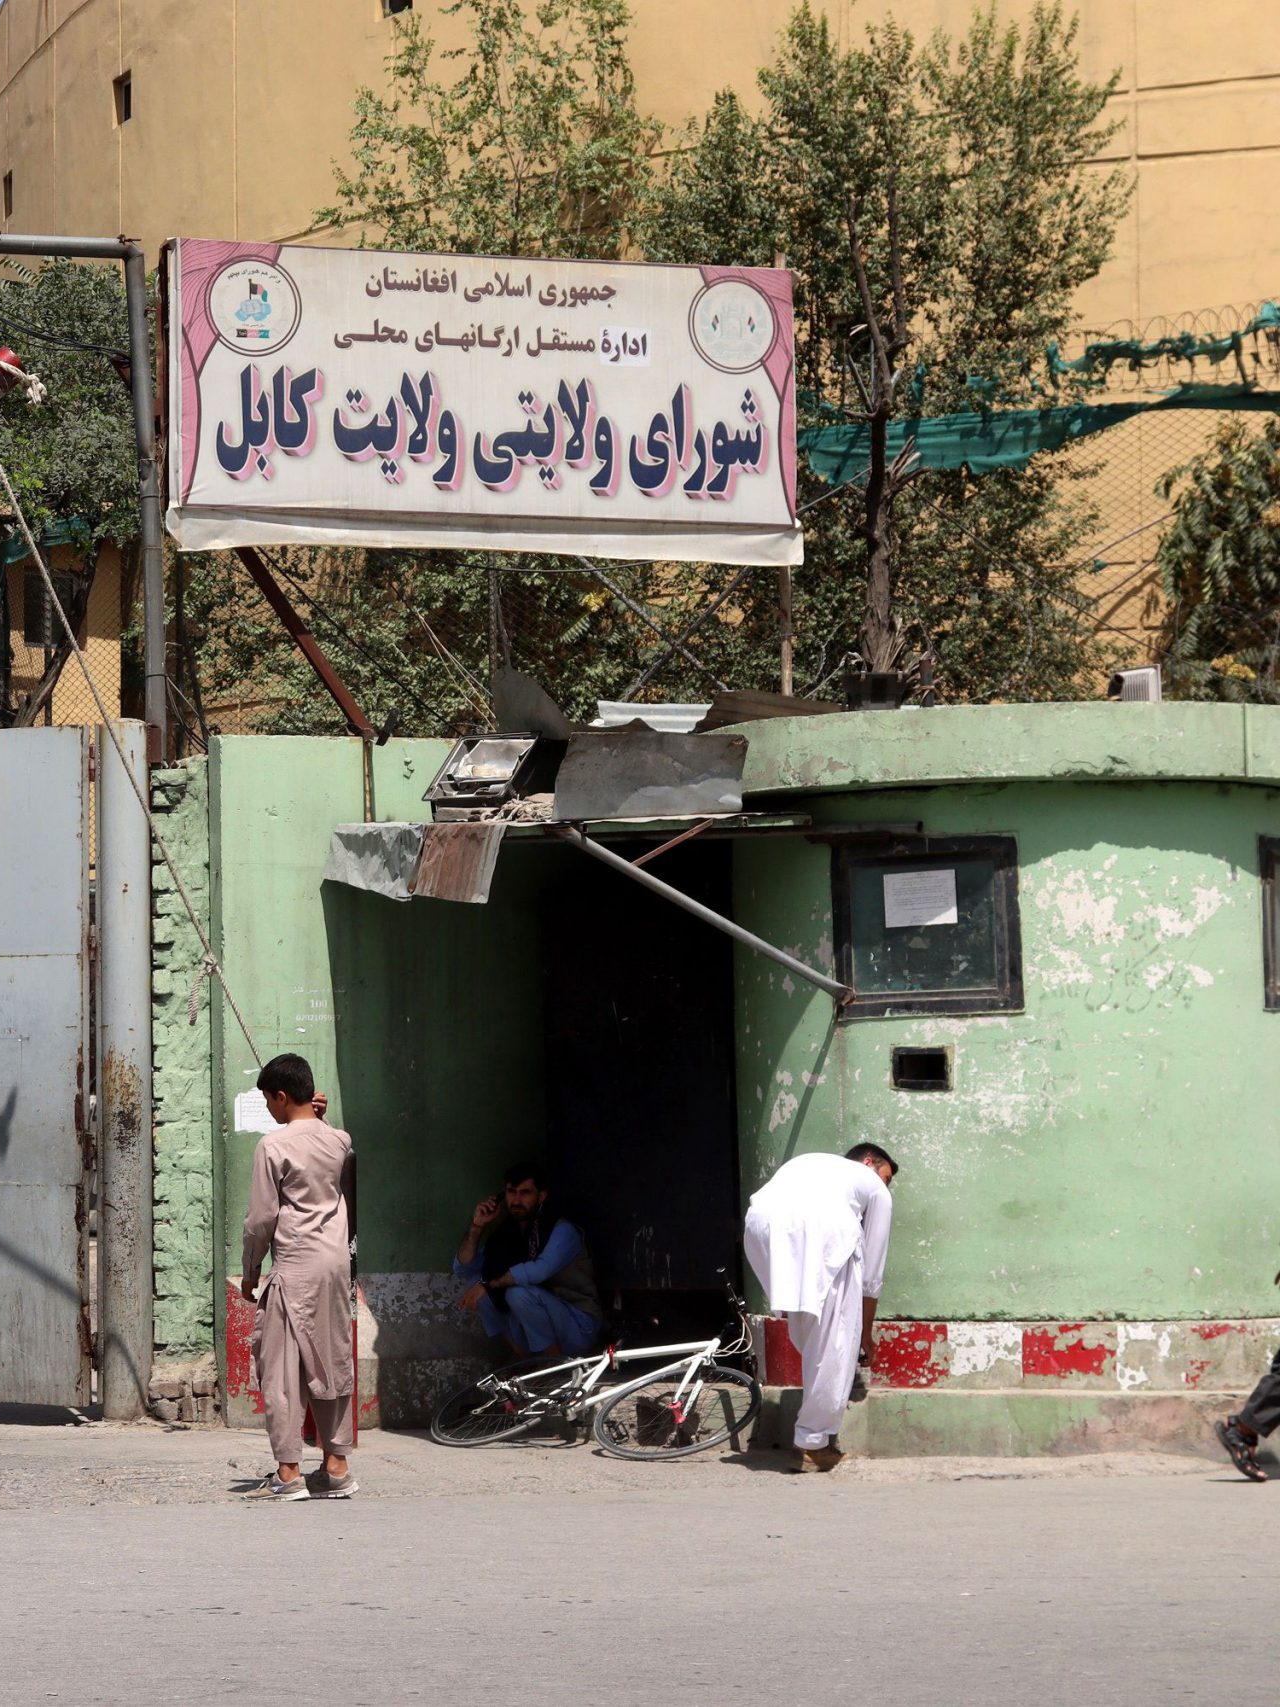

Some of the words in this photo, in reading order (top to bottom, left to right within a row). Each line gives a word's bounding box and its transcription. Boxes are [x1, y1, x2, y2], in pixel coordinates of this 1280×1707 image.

[364, 266, 458, 297] افغانستان
[463, 271, 533, 303] اسلامی
[538, 282, 617, 309] جمهوری
[333, 318, 409, 349] محلی
[414, 321, 520, 357] ارگانهای
[525, 326, 596, 357] مستقل
[216, 363, 325, 481] کابل
[332, 370, 464, 491] ولایت
[472, 377, 620, 497] ولایتی
[629, 383, 769, 500] شورای
